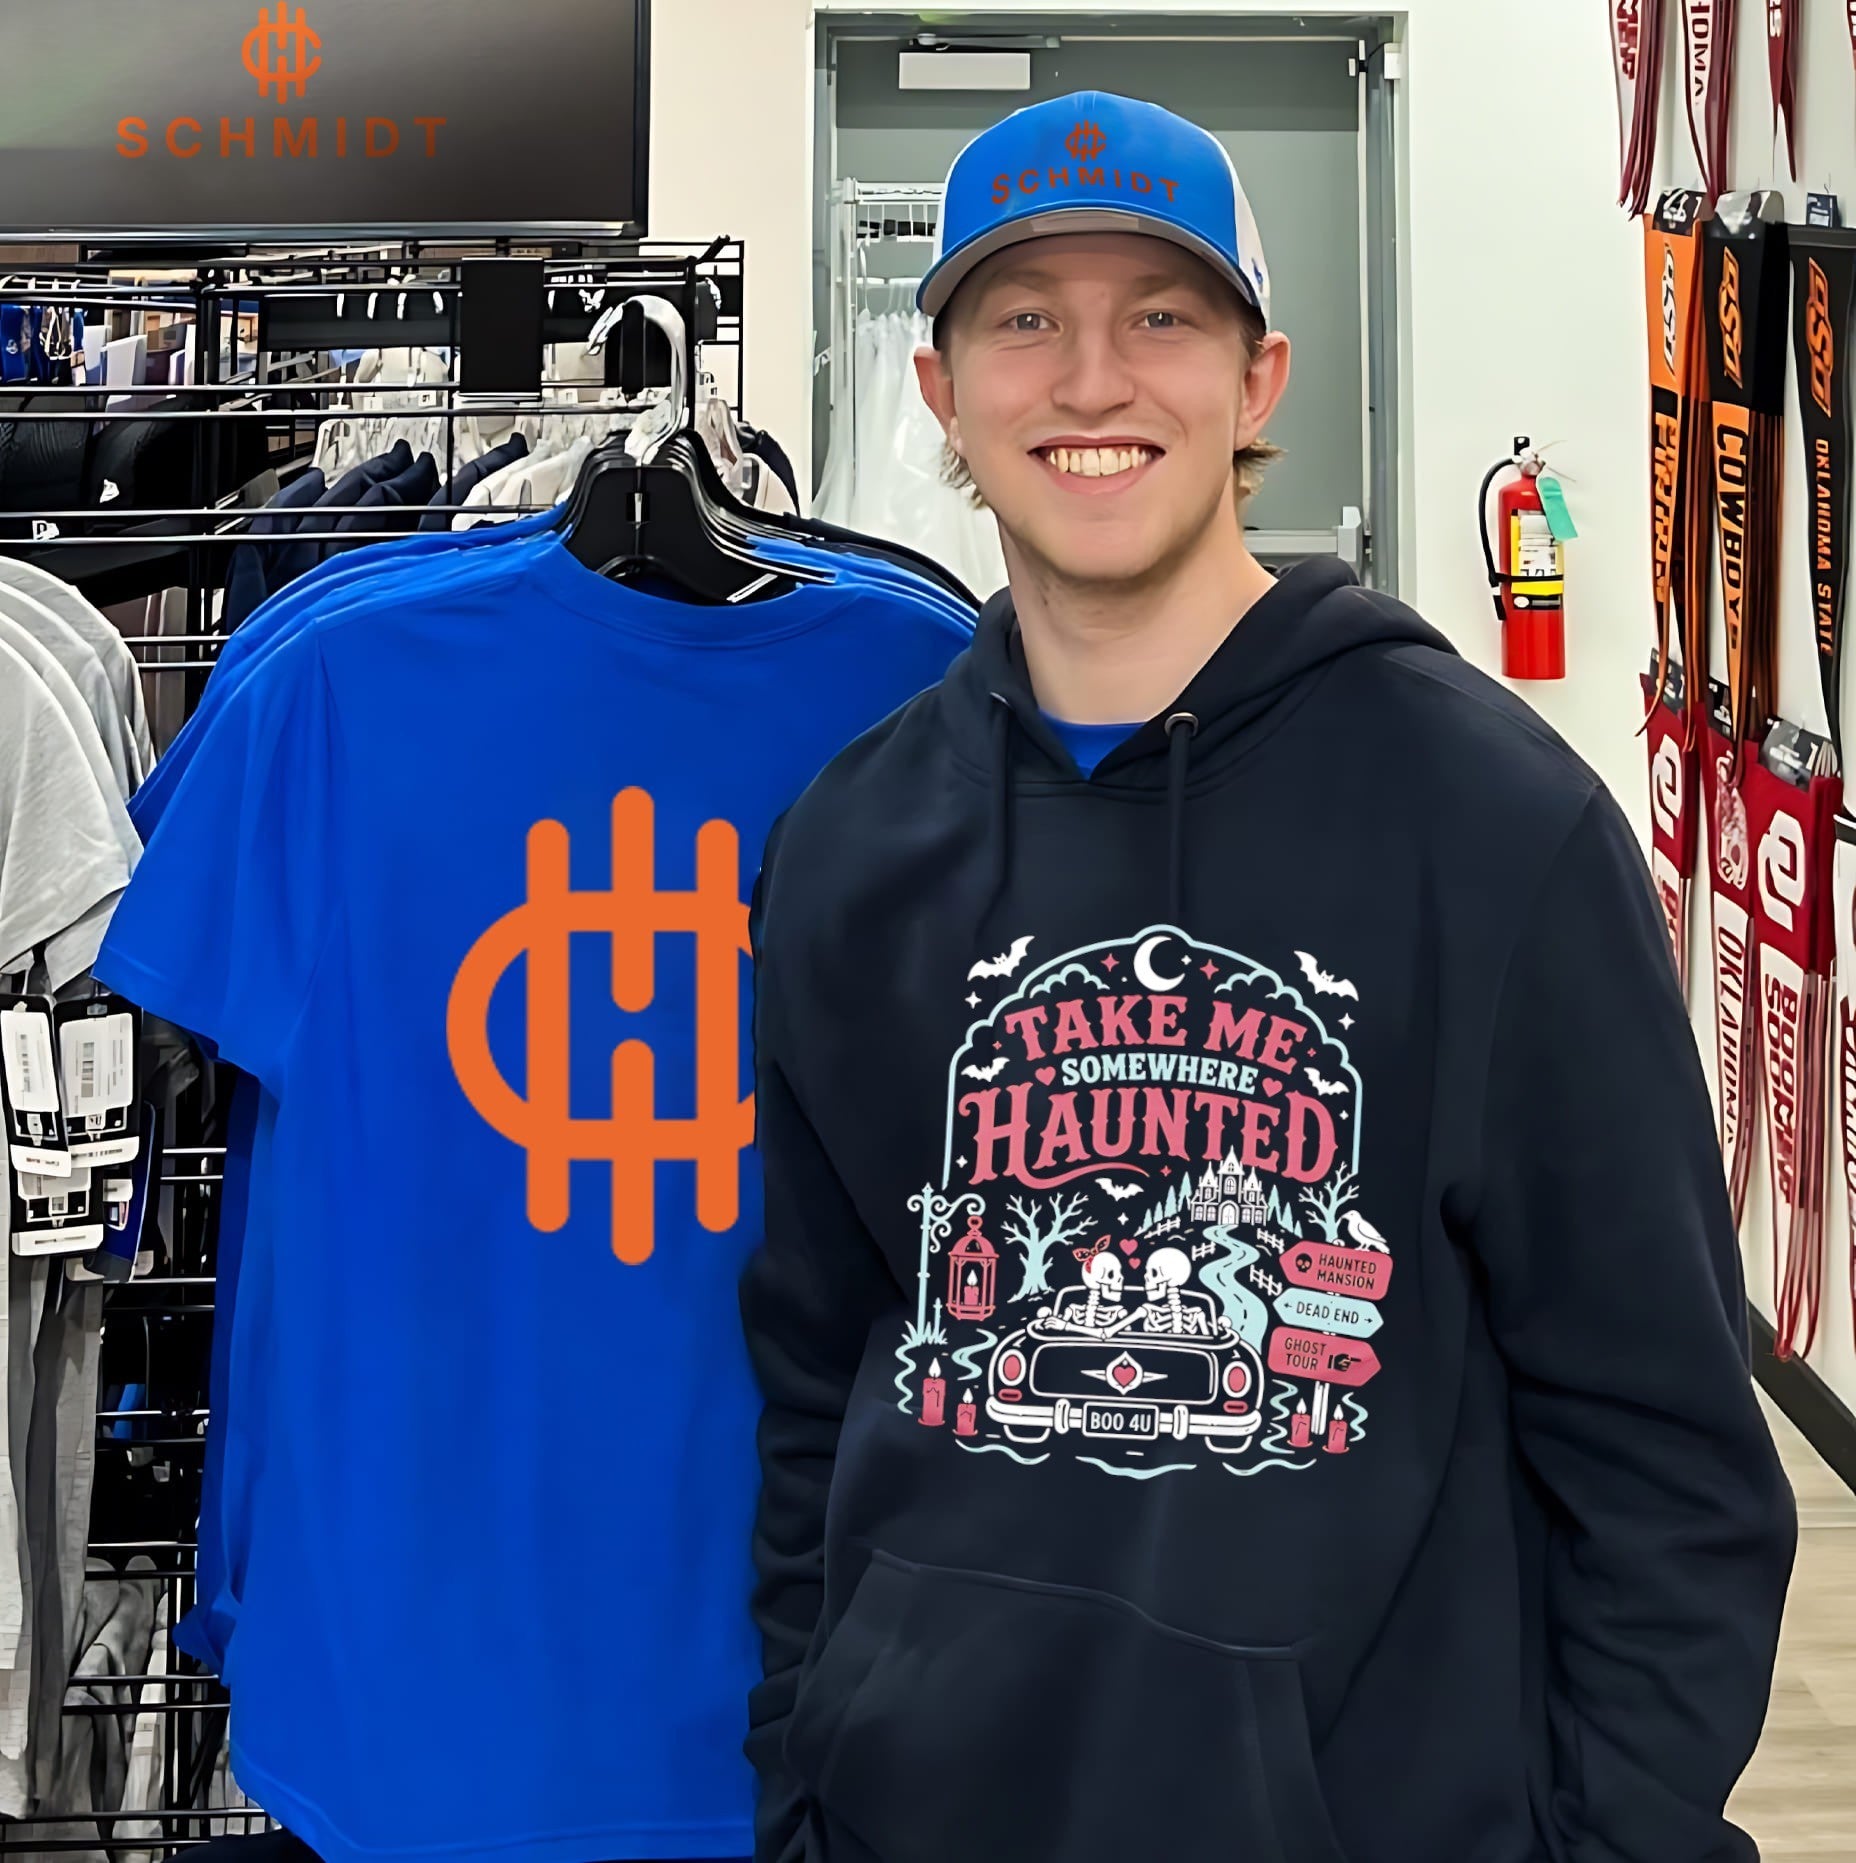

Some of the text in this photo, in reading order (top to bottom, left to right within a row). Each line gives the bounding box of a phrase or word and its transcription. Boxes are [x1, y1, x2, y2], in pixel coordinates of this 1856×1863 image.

[116, 116, 448, 159] SCHMIDT
[991, 166, 1179, 205] SCHMIDT
[1815, 437, 1832, 571] OKLAHOMA
[1004, 994, 1309, 1075] TAKE ME
[1718, 925, 1745, 1144] OKLAHOMA
[1061, 1053, 1259, 1096] SOMEWHERE
[958, 1081, 1338, 1190] HAUNTED
[1316, 1269, 1375, 1290] MANSION
[1318, 1253, 1377, 1275] HAUNTED
[1296, 1301, 1359, 1325] DEAD END
[1284, 1337, 1328, 1356] GHOST
[1285, 1353, 1319, 1371] TOUR
[1090, 1411, 1152, 1433] BOO 4U
